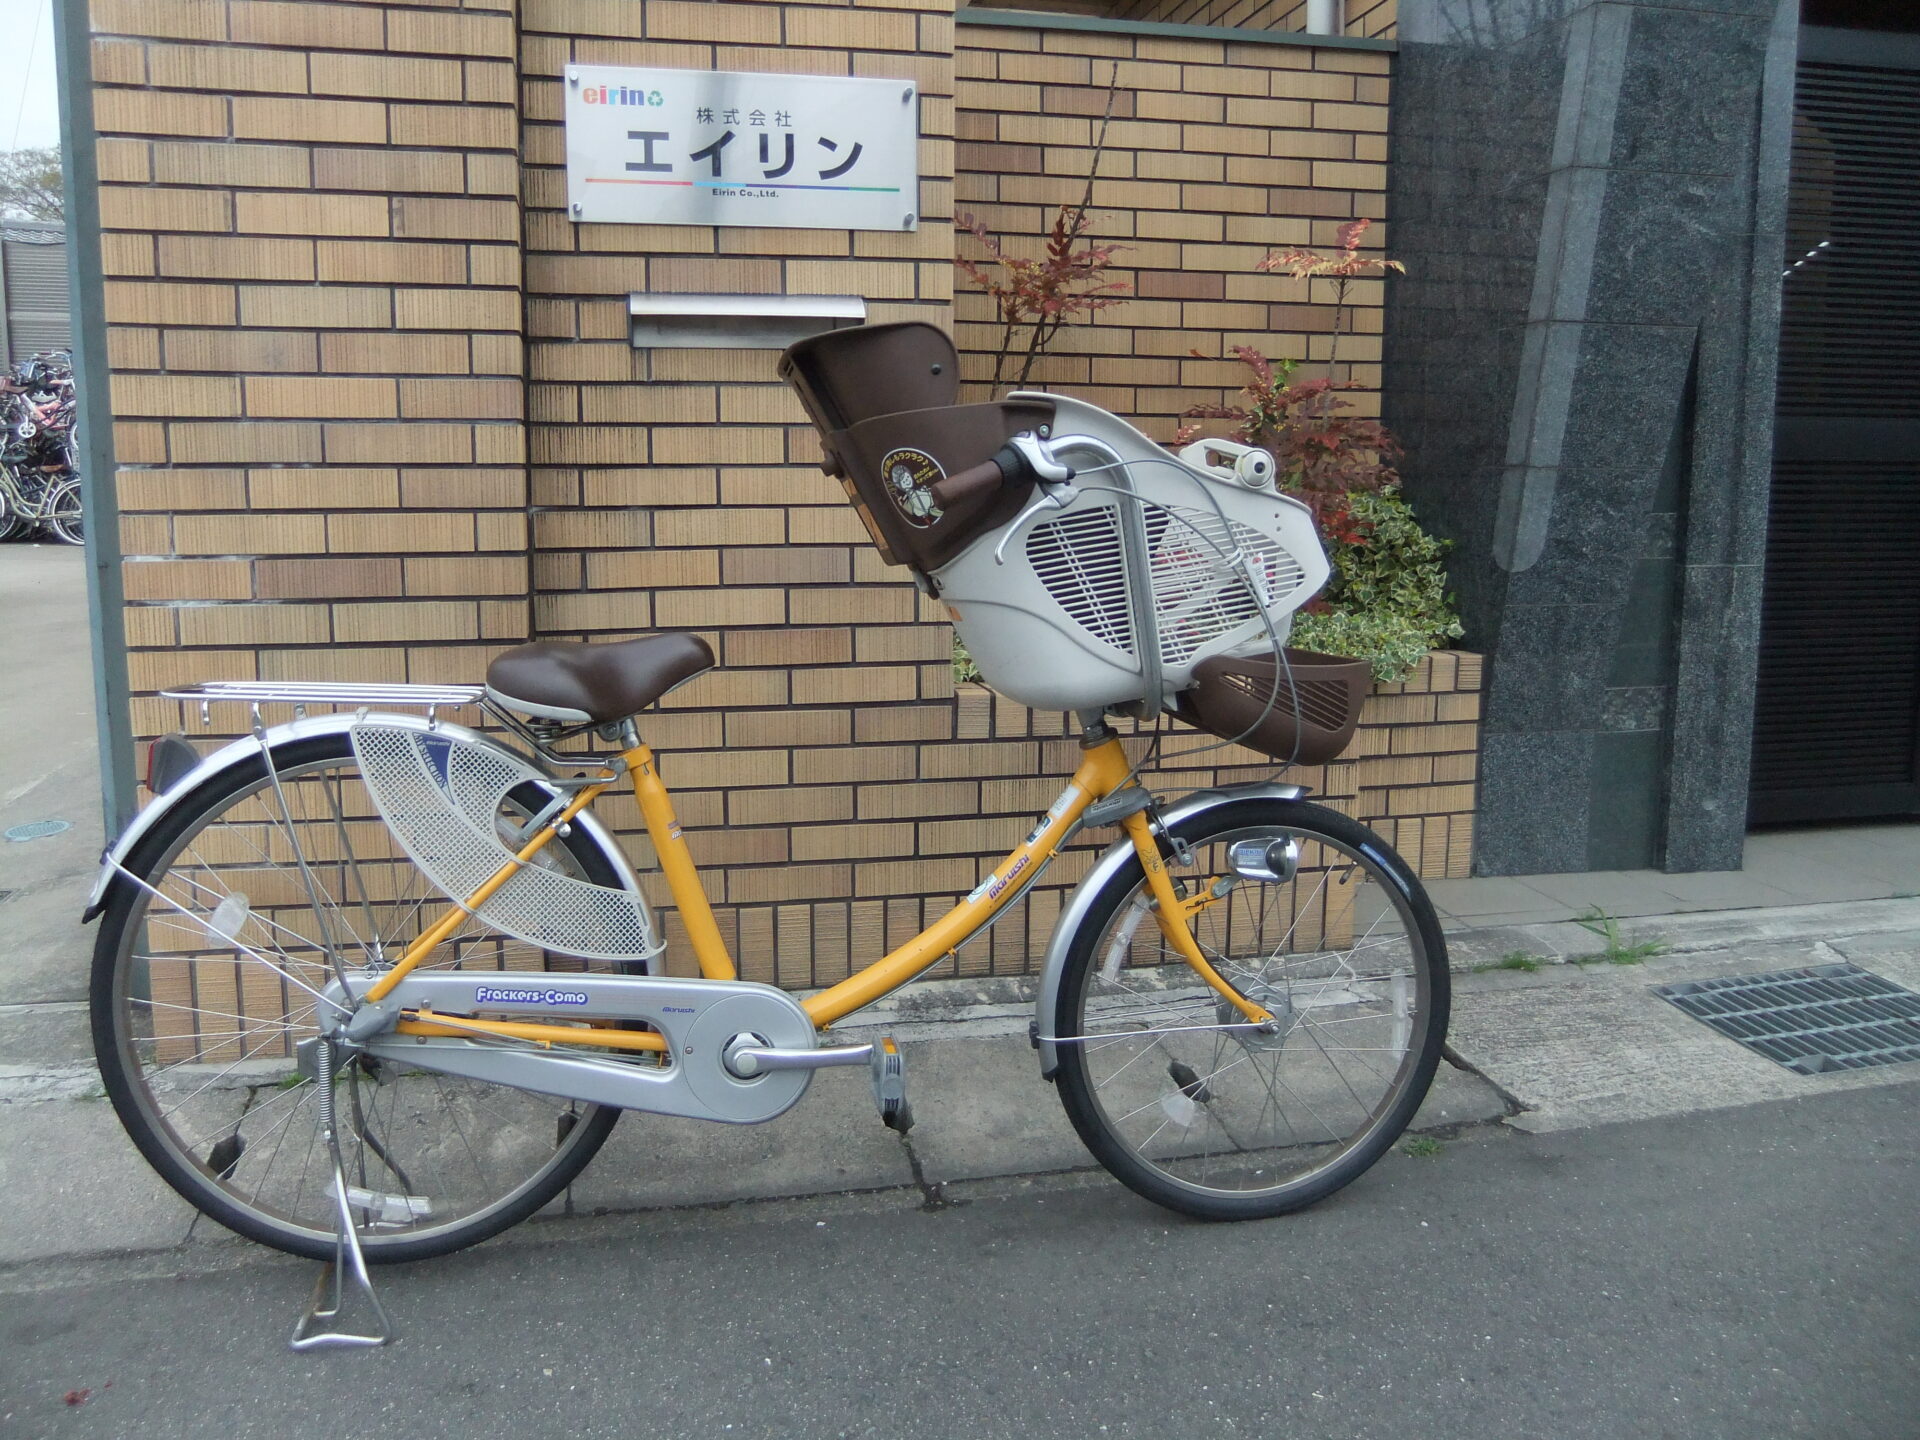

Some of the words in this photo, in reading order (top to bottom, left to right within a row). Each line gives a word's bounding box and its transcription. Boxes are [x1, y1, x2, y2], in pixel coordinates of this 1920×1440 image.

[582, 85, 645, 106] eirin
[696, 106, 793, 128] 株式会社
[625, 130, 863, 181] エイリン
[712, 188, 736, 198] Eirin
[476, 986, 588, 1005] Frackers-Como
